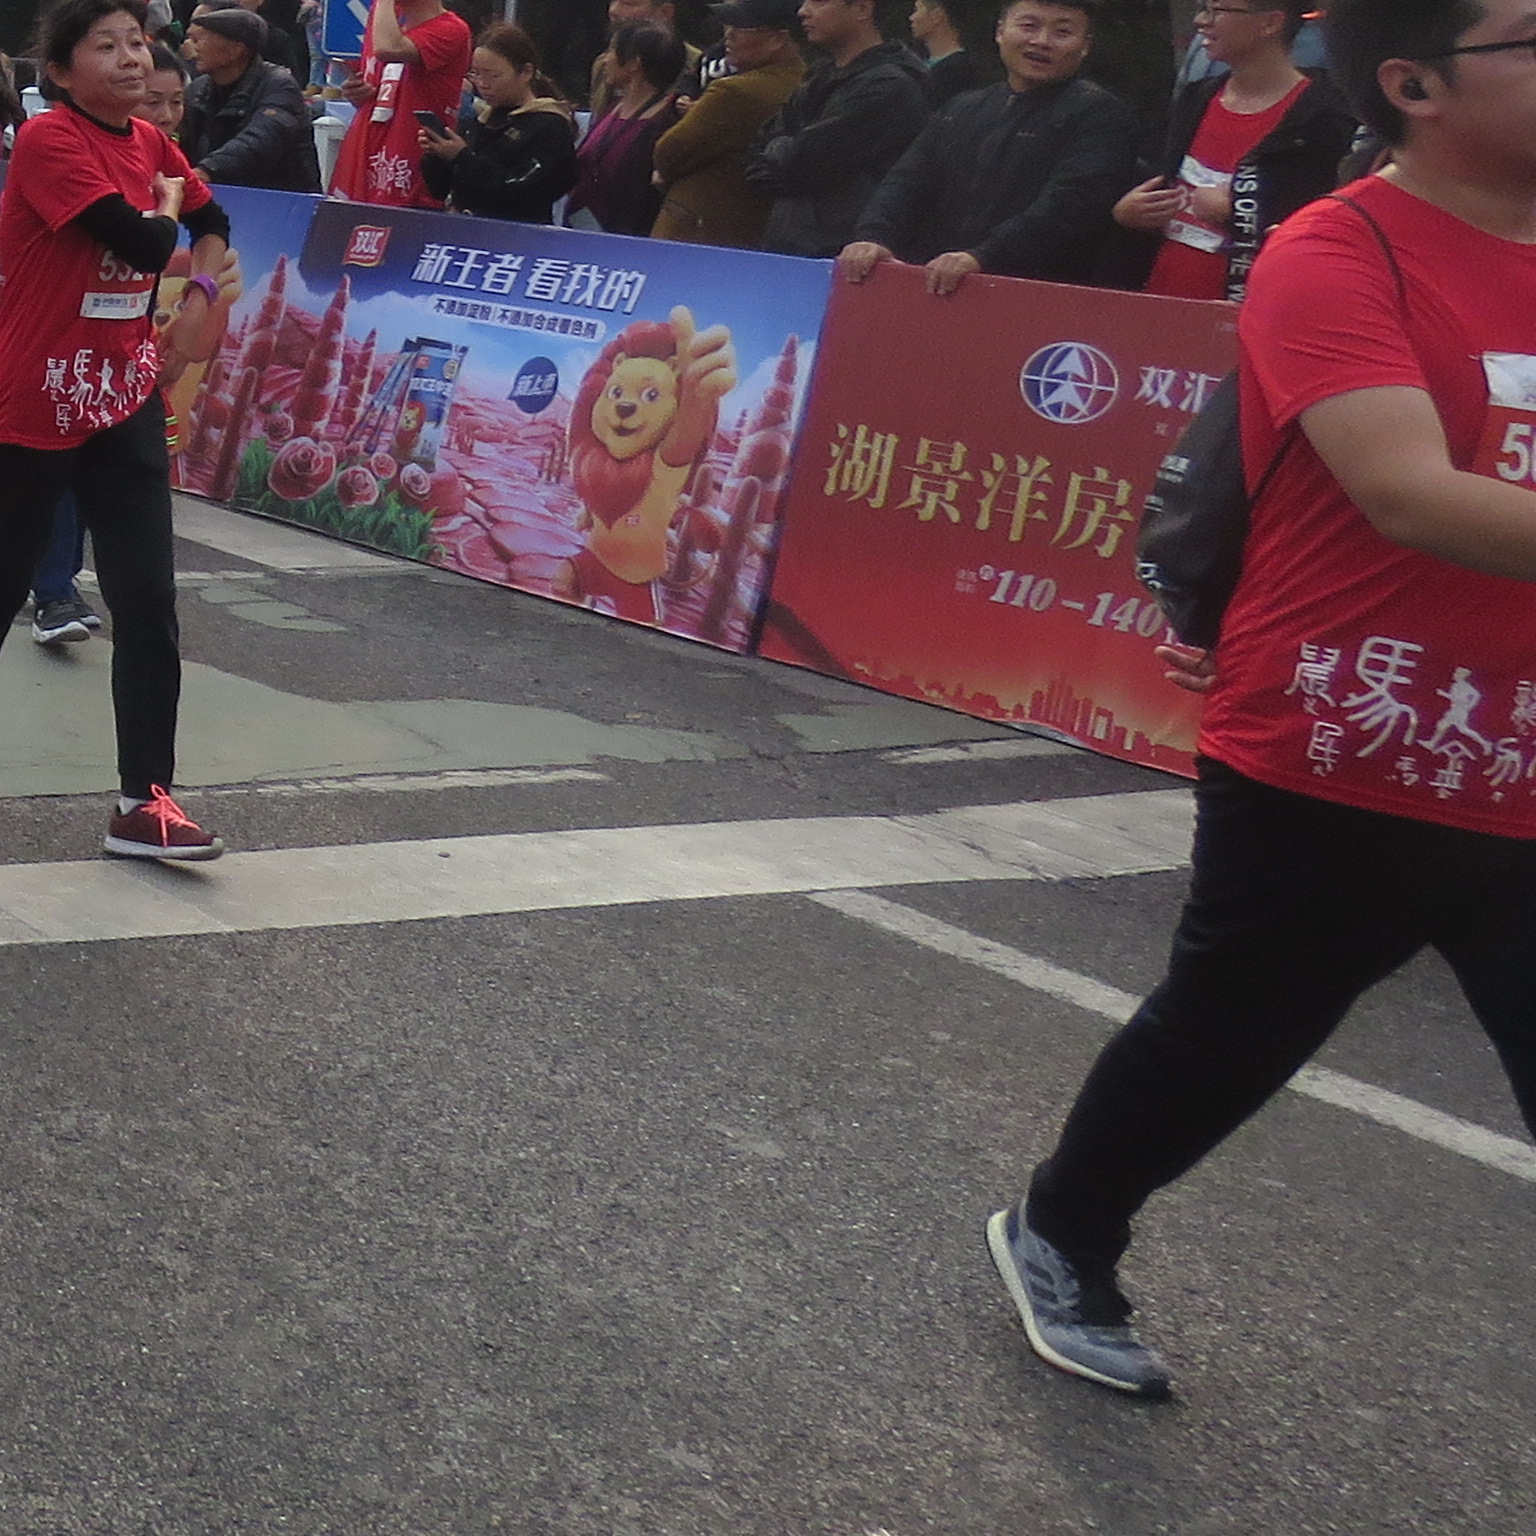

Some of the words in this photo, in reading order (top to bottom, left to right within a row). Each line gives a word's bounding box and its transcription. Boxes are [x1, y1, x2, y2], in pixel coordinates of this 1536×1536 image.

[411, 242, 525, 296] 新王者
[526, 257, 648, 314] 看我的
[1495, 421, 1536, 482] 5
[823, 422, 1137, 560] 湖景洋房
